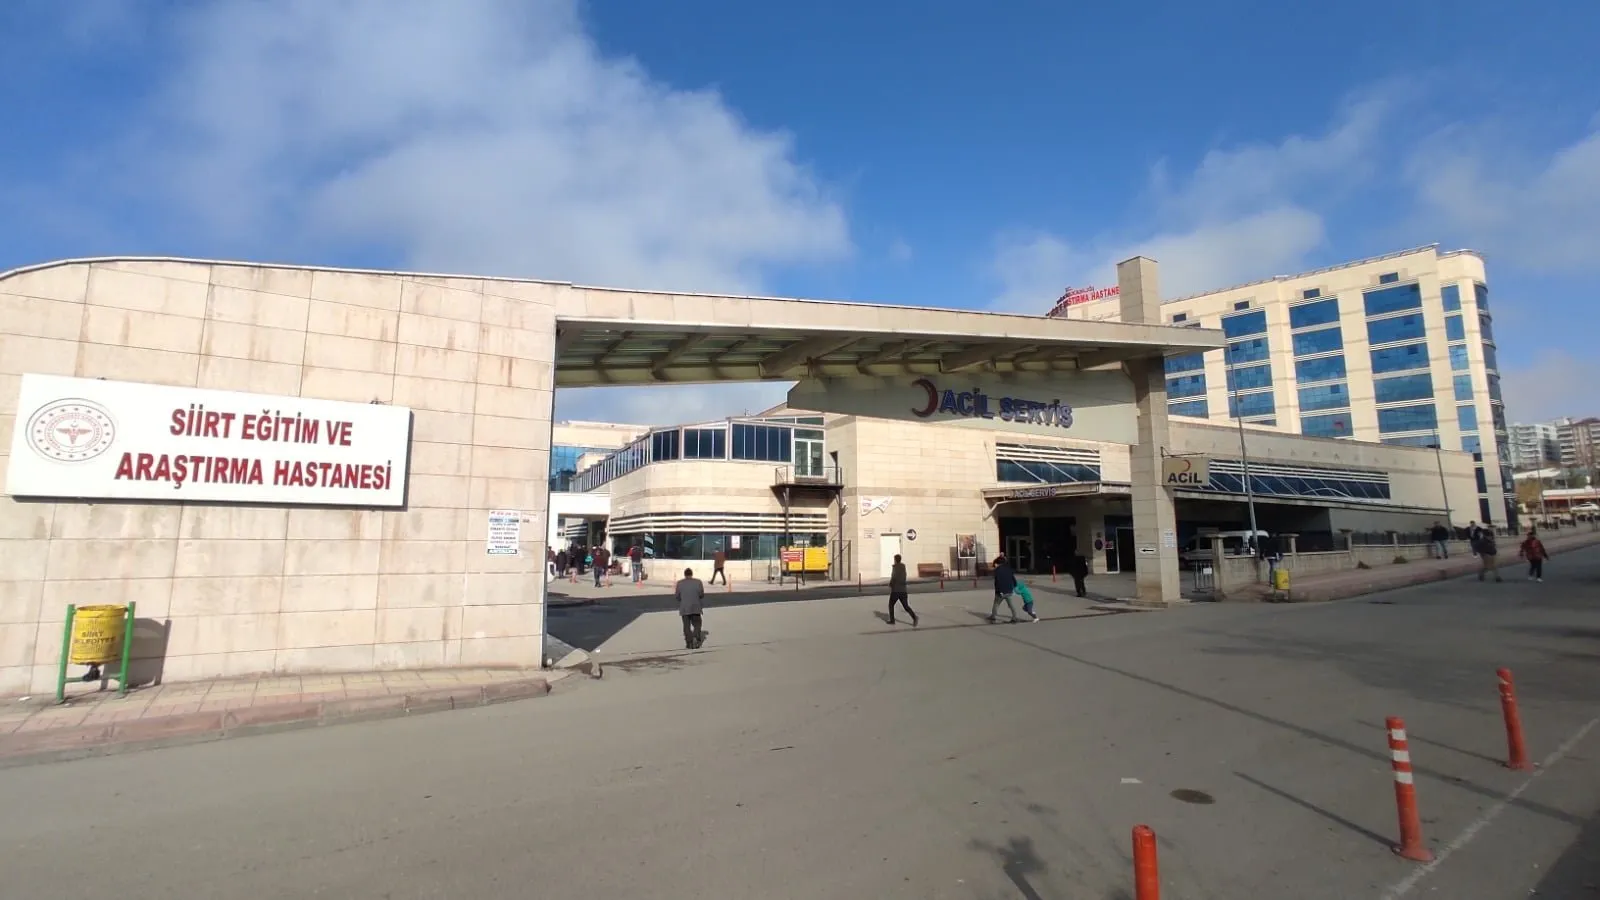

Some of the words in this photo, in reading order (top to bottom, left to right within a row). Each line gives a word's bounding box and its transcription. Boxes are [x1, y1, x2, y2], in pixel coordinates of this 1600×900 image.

[169, 403, 236, 438] SİİRT
[241, 409, 319, 444] EĞİTİM
[326, 420, 353, 446] VE
[114, 452, 263, 489] ARAŞTIRMA
[273, 460, 392, 490] HASTANESİ
